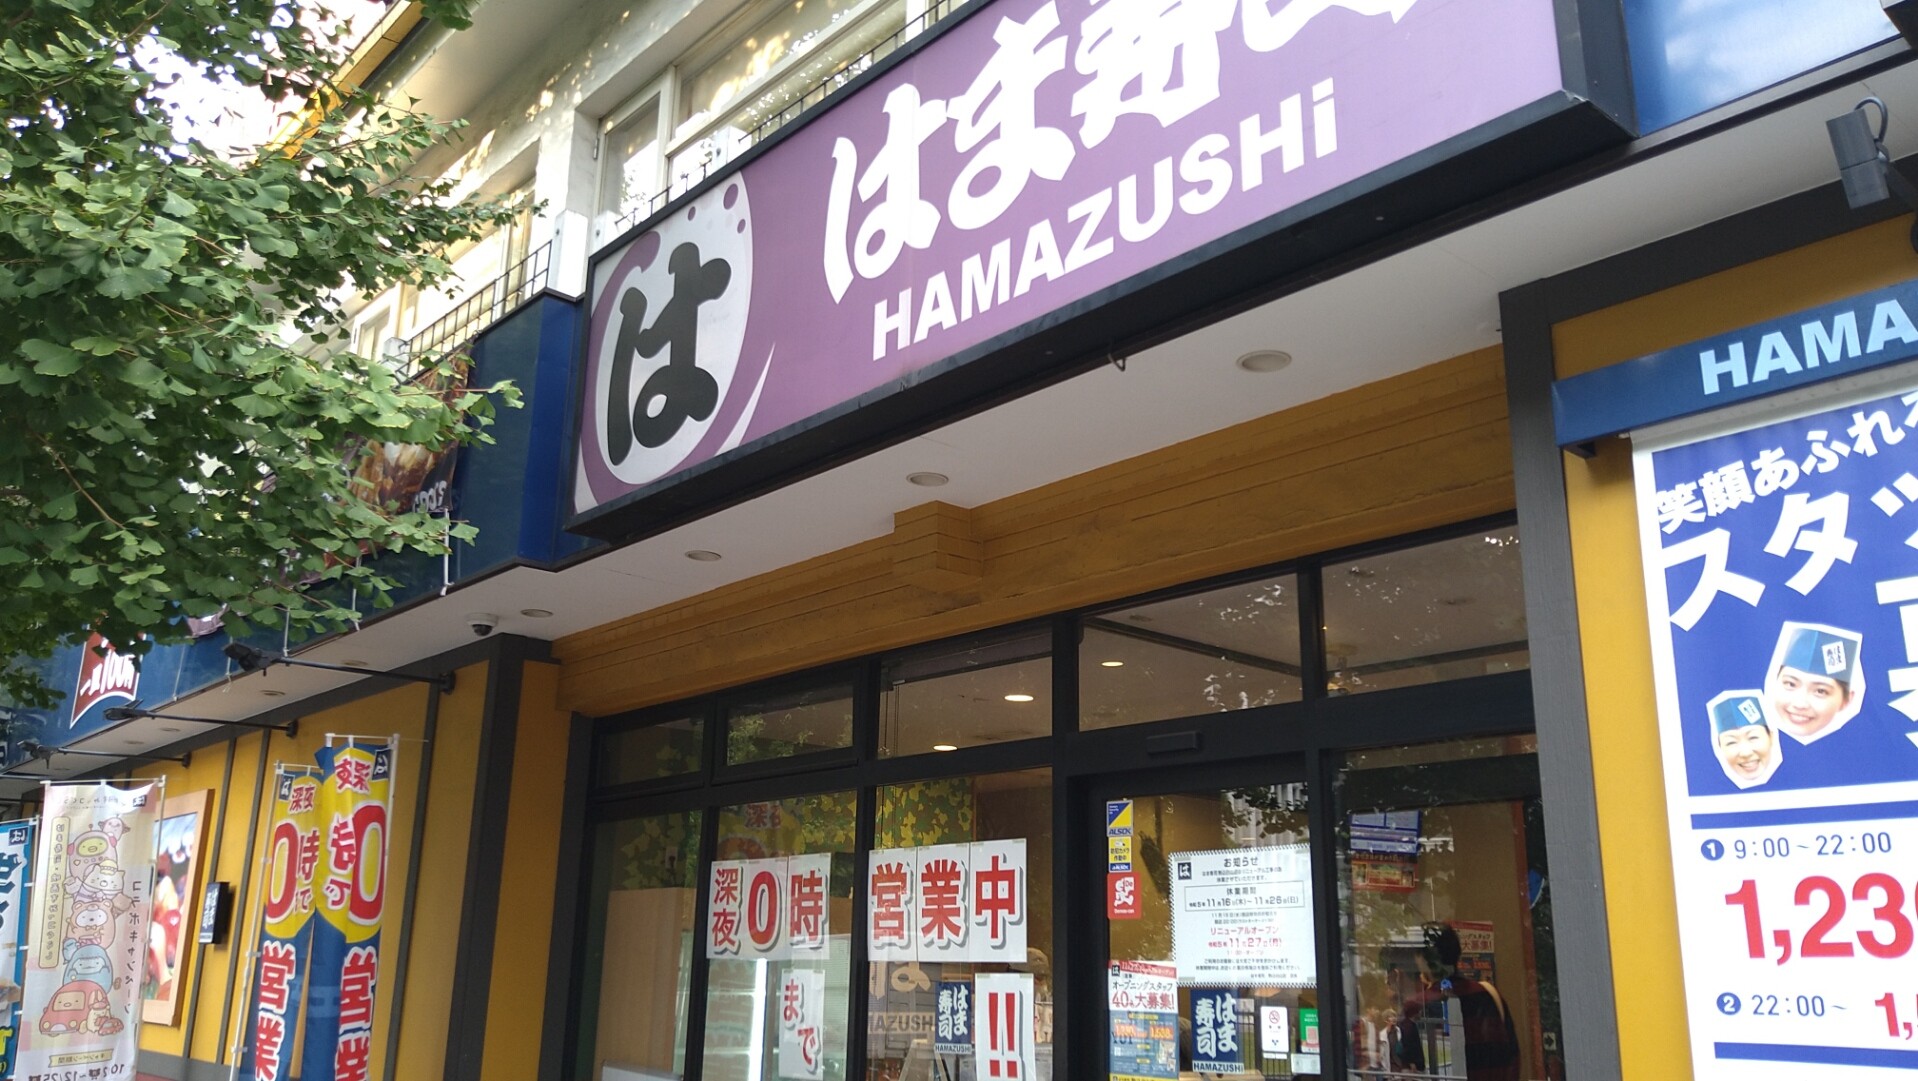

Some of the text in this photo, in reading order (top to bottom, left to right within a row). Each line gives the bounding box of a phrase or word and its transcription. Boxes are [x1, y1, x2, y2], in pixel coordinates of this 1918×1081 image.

[824, 0, 1415, 303] はま寿
[608, 241, 731, 465] は
[1700, 299, 1918, 395] HAMA
[871, 855, 1017, 940] 営業中
[1223, 856, 1259, 868] お知らせ
[1226, 886, 1257, 896] 休業期間
[711, 867, 740, 948] 深夜
[1210, 926, 1279, 936] リニューアルオープン
[1725, 872, 1918, 966] 1,23
[783, 978, 817, 1066] まで
[1112, 980, 1174, 992] オープニングスタッフ
